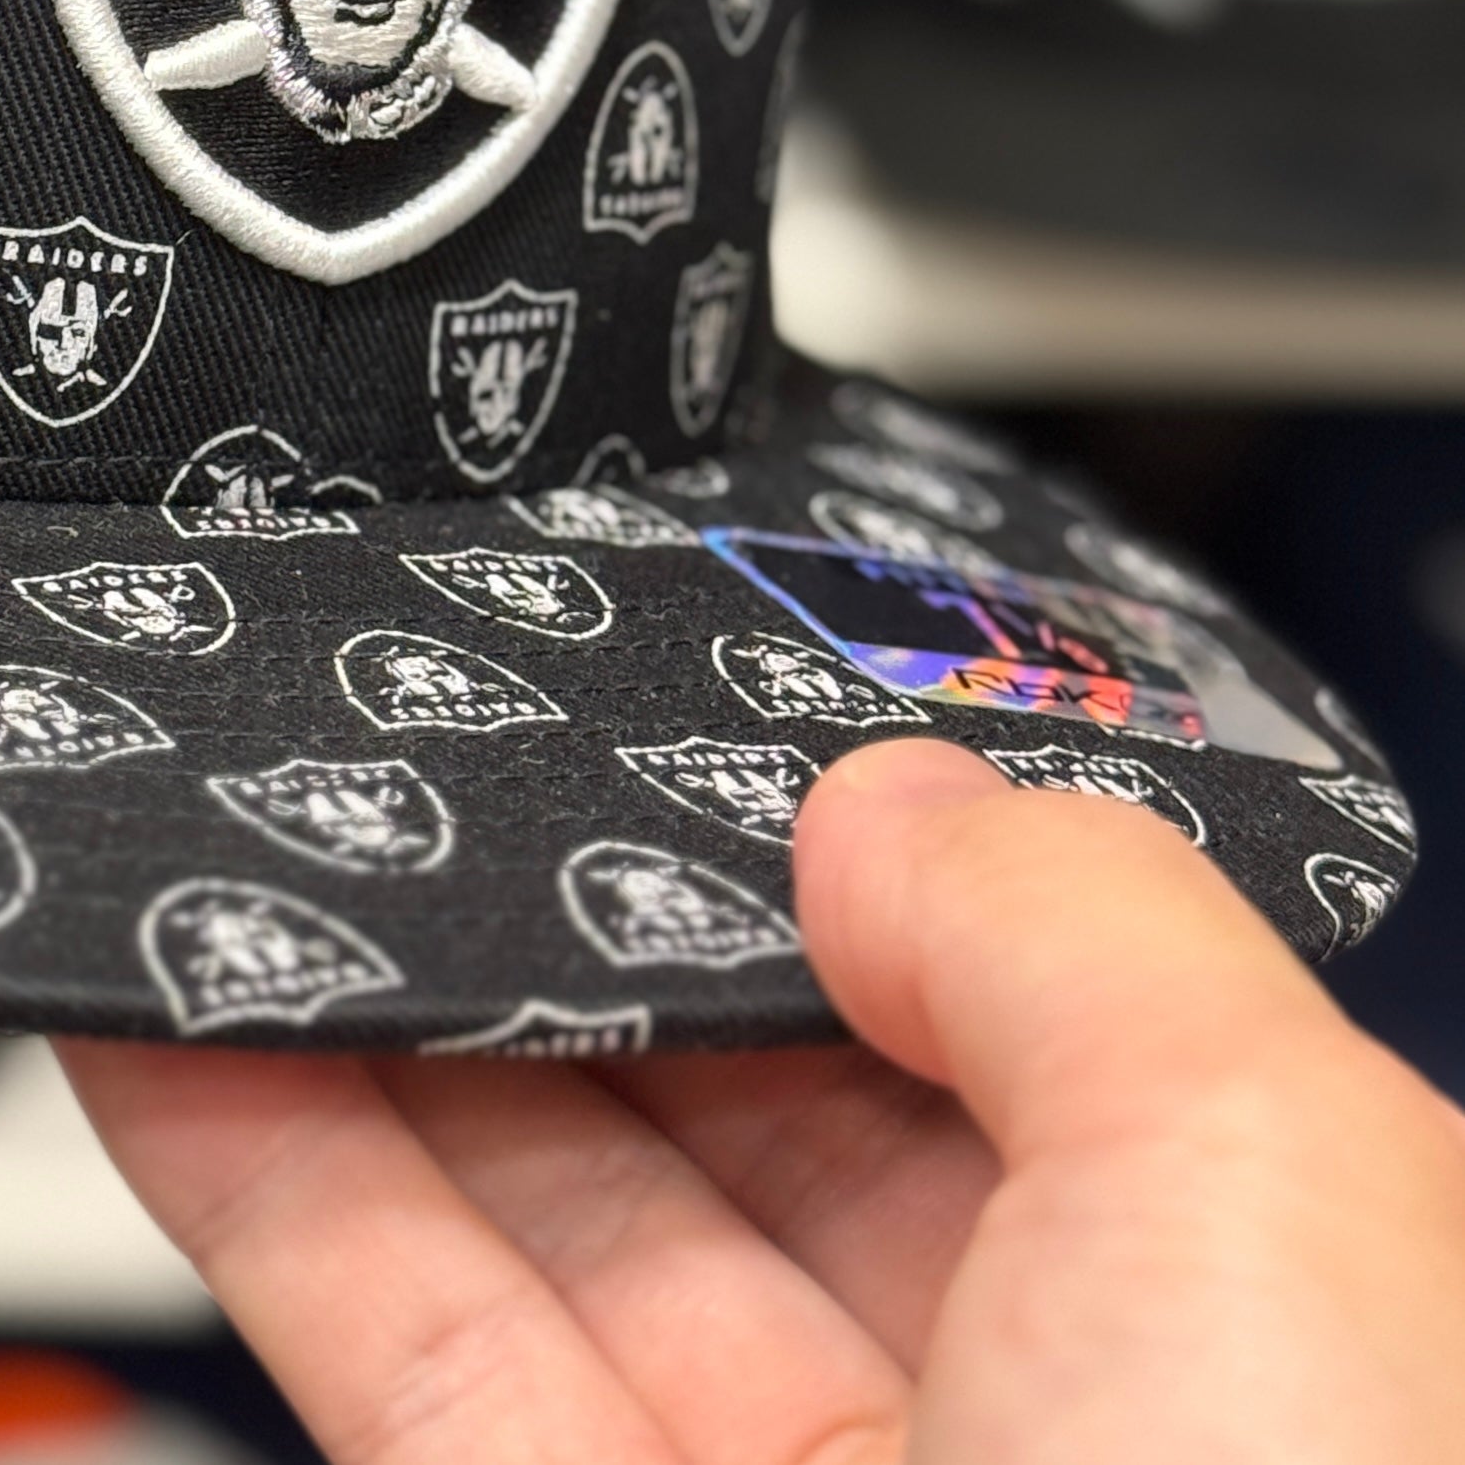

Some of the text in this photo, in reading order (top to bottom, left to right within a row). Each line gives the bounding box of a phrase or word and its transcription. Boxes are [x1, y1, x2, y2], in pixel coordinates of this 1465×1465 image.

[1, 240, 148, 276] RAIDERS
[42, 570, 190, 594] RAIDERS
[389, 701, 537, 722] RAIDERS
